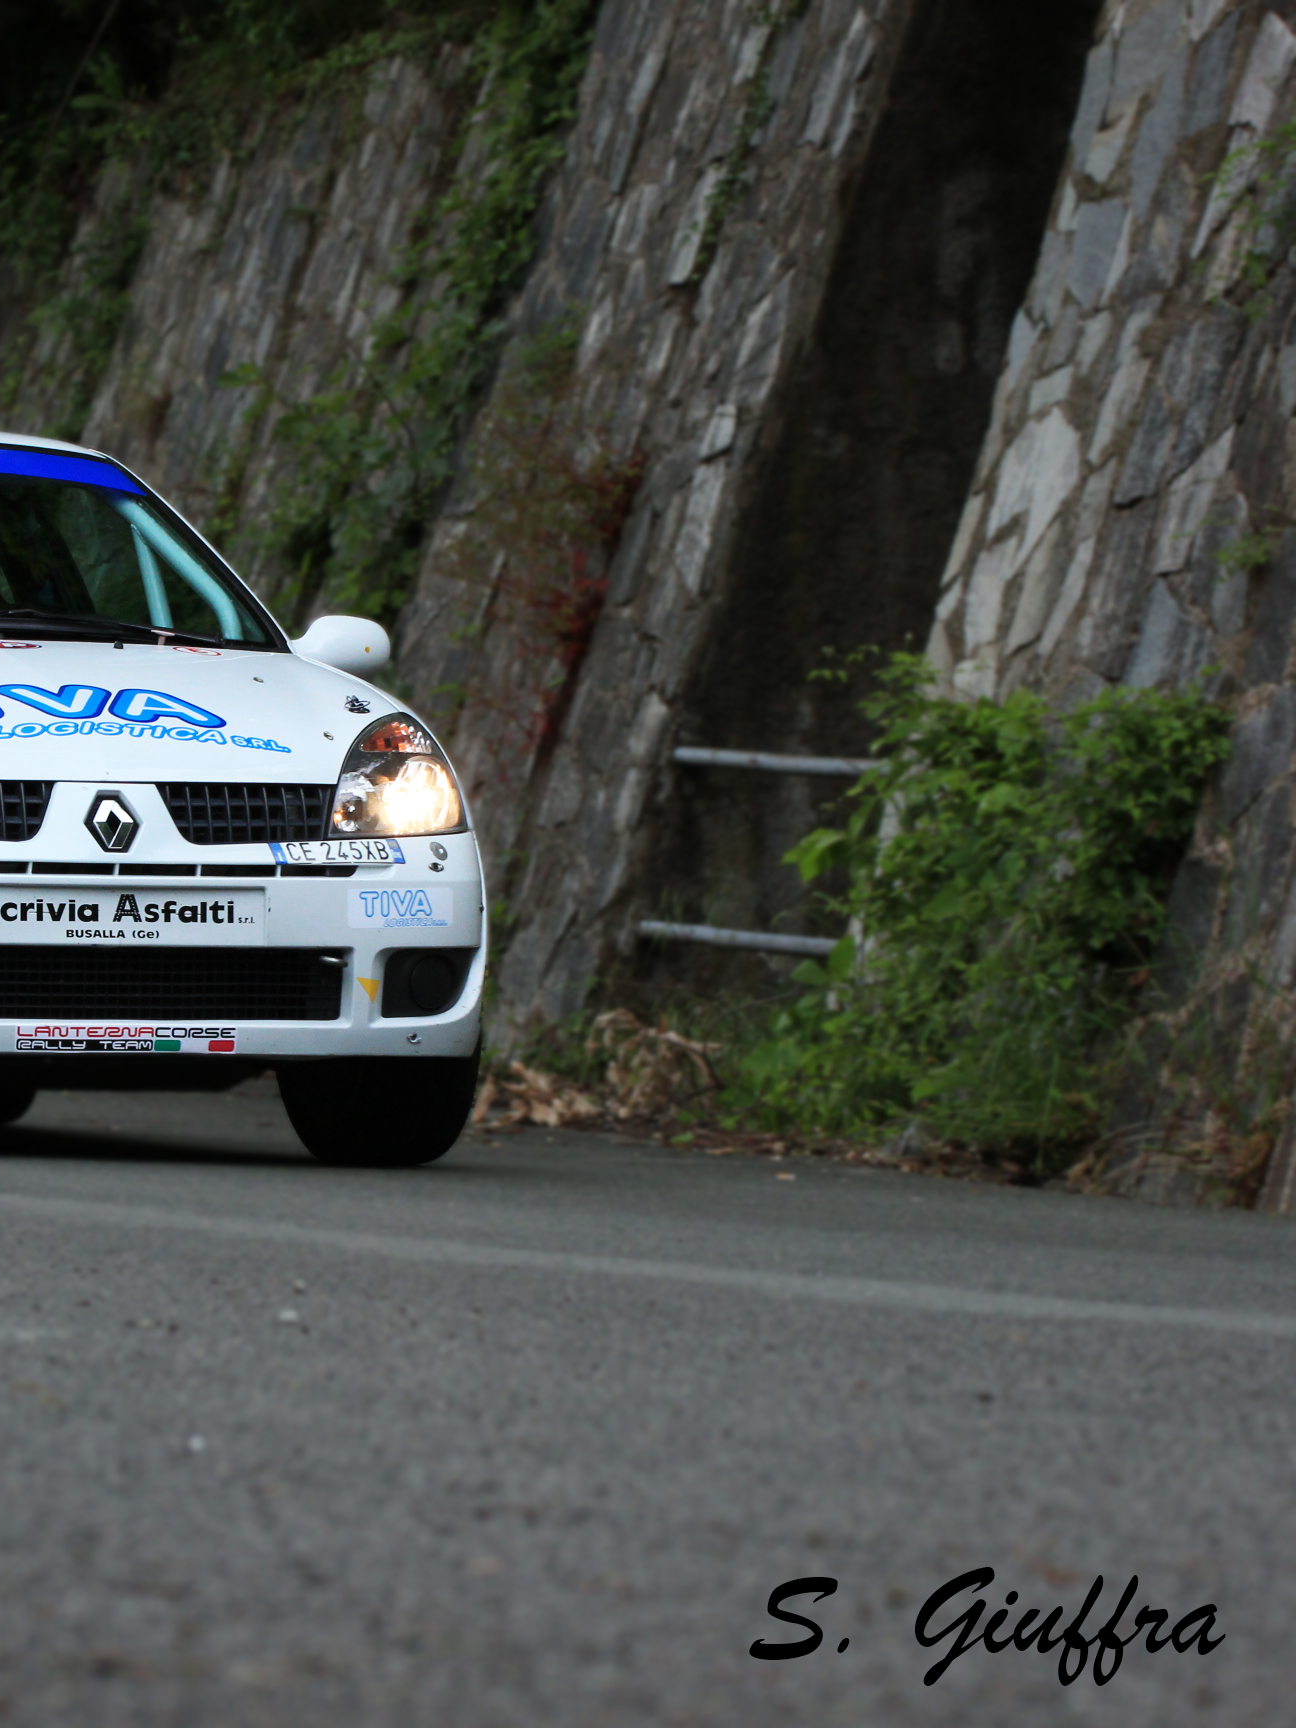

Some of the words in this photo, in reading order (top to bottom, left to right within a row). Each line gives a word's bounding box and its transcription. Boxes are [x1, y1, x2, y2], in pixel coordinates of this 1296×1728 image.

[230, 735, 292, 754] S.R.L.
[286, 842, 316, 861] CE
[319, 841, 390, 861] 245XB
[112, 893, 235, 924] Asfalti
[237, 915, 256, 924] s.r.l.
[359, 889, 432, 917] TIVA
[383, 917, 432, 927] LOGISTICA
[65, 929, 126, 939] BUSALLA
[132, 929, 160, 940] (Ge)
[18, 1040, 87, 1050] RALLY
[99, 1040, 152, 1050] TEAM
